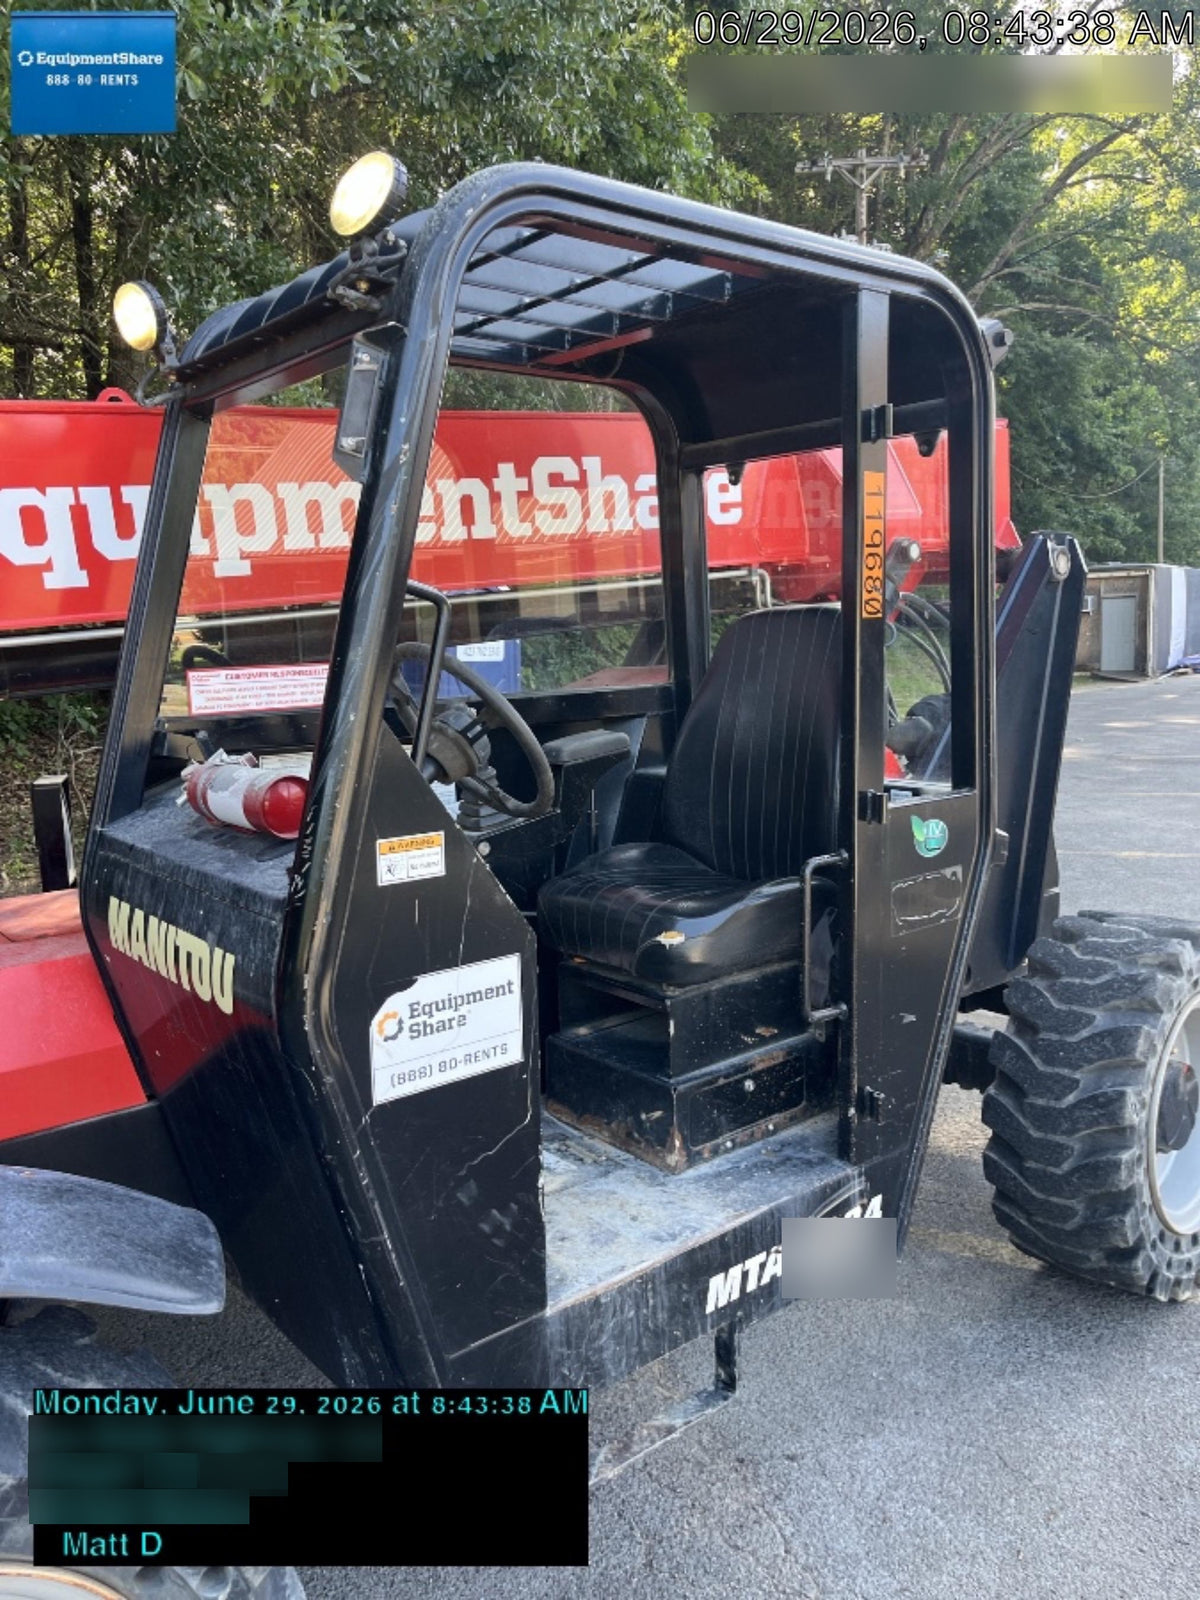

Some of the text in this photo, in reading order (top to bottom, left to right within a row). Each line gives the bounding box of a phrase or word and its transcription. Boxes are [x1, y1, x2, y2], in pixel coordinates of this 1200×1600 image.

[108, 895, 235, 1015] MANITOU
[408, 979, 514, 1020] Equipment
[408, 1014, 467, 1041] Share
[391, 1043, 508, 1088] (888) 80-RENTS
